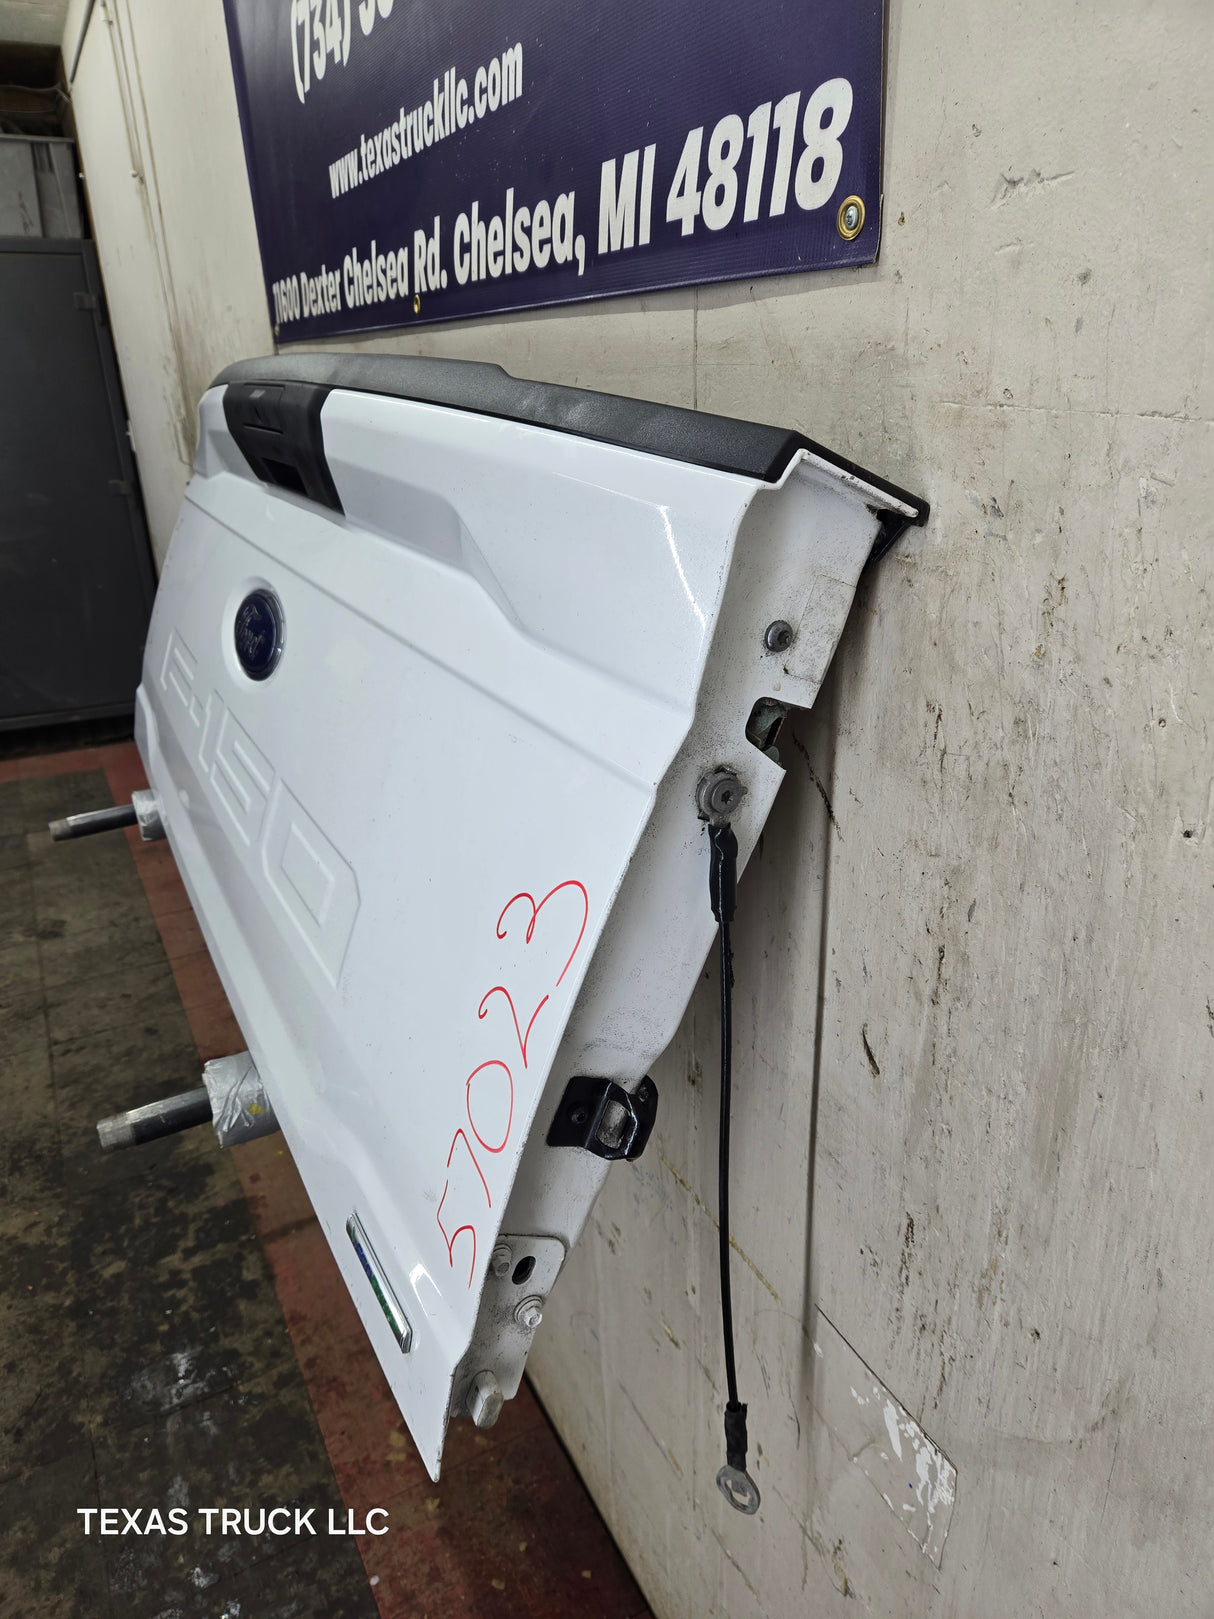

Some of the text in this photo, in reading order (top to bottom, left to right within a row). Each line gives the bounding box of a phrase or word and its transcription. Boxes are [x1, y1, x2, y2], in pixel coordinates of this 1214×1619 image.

[291, 0, 351, 104] (734)
[328, 42, 523, 199] www.texastruckllc.com
[300, 264, 341, 318] Dexter
[343, 239, 409, 309] Chelsea
[413, 215, 448, 294] Rd.
[453, 187, 586, 285] Chelsea,
[597, 143, 657, 255] MI
[665, 78, 854, 237] 48118
[436, 879, 589, 1290] 57023
